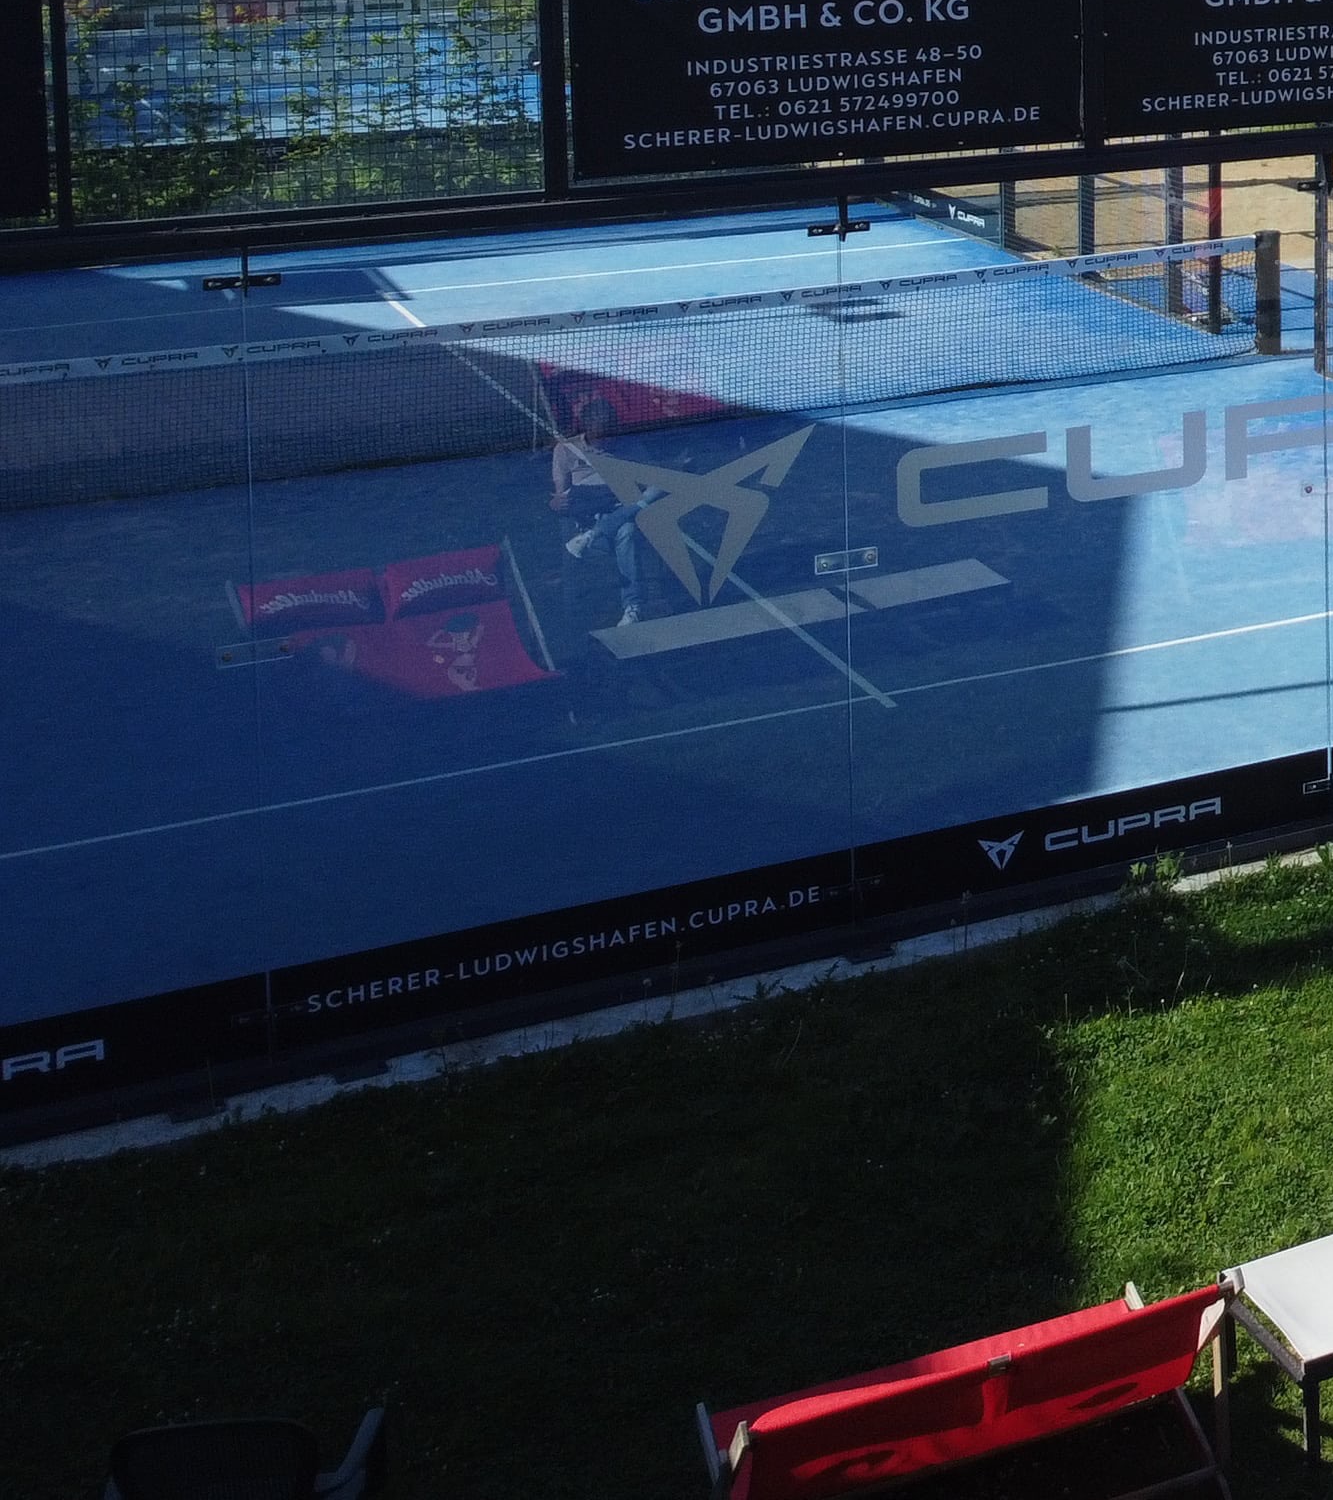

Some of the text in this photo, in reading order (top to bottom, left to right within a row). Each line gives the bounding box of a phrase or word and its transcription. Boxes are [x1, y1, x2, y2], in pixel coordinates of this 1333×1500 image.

[820, 4, 843, 28] &
[686, 44, 983, 78] INDUSTRIESTRASSE 48-50
[1212, 48, 1270, 66] 67063
[709, 67, 964, 99] 67063 LUDWIGSHAFEN
[1215, 69, 1262, 87] TEL.:
[1268, 66, 1313, 83] 0621
[714, 89, 960, 121] TEL.: 0621 572499700
[624, 105, 1041, 151] SCHERER-LUDWIGSHAFEN.CUPRA.DE
[1171, 243, 1224, 256] CUPRA
[1084, 253, 1139, 266] CUPRA
[993, 264, 1049, 278] CUPRA
[899, 274, 957, 287] CUPRA
[801, 284, 862, 298] CUPRA
[700, 295, 762, 309] CUPRA
[592, 306, 658, 320] CUPRA
[482, 317, 550, 332] CUPRA
[368, 329, 438, 342] CUPRA
[246, 340, 321, 354] CUPRA
[121, 351, 198, 366] CUPRA
[1044, 796, 1222, 852] CUPRA
[305, 886, 822, 1016] SCHERER-LUDWIGSHAFEN.CUPRA.DE
